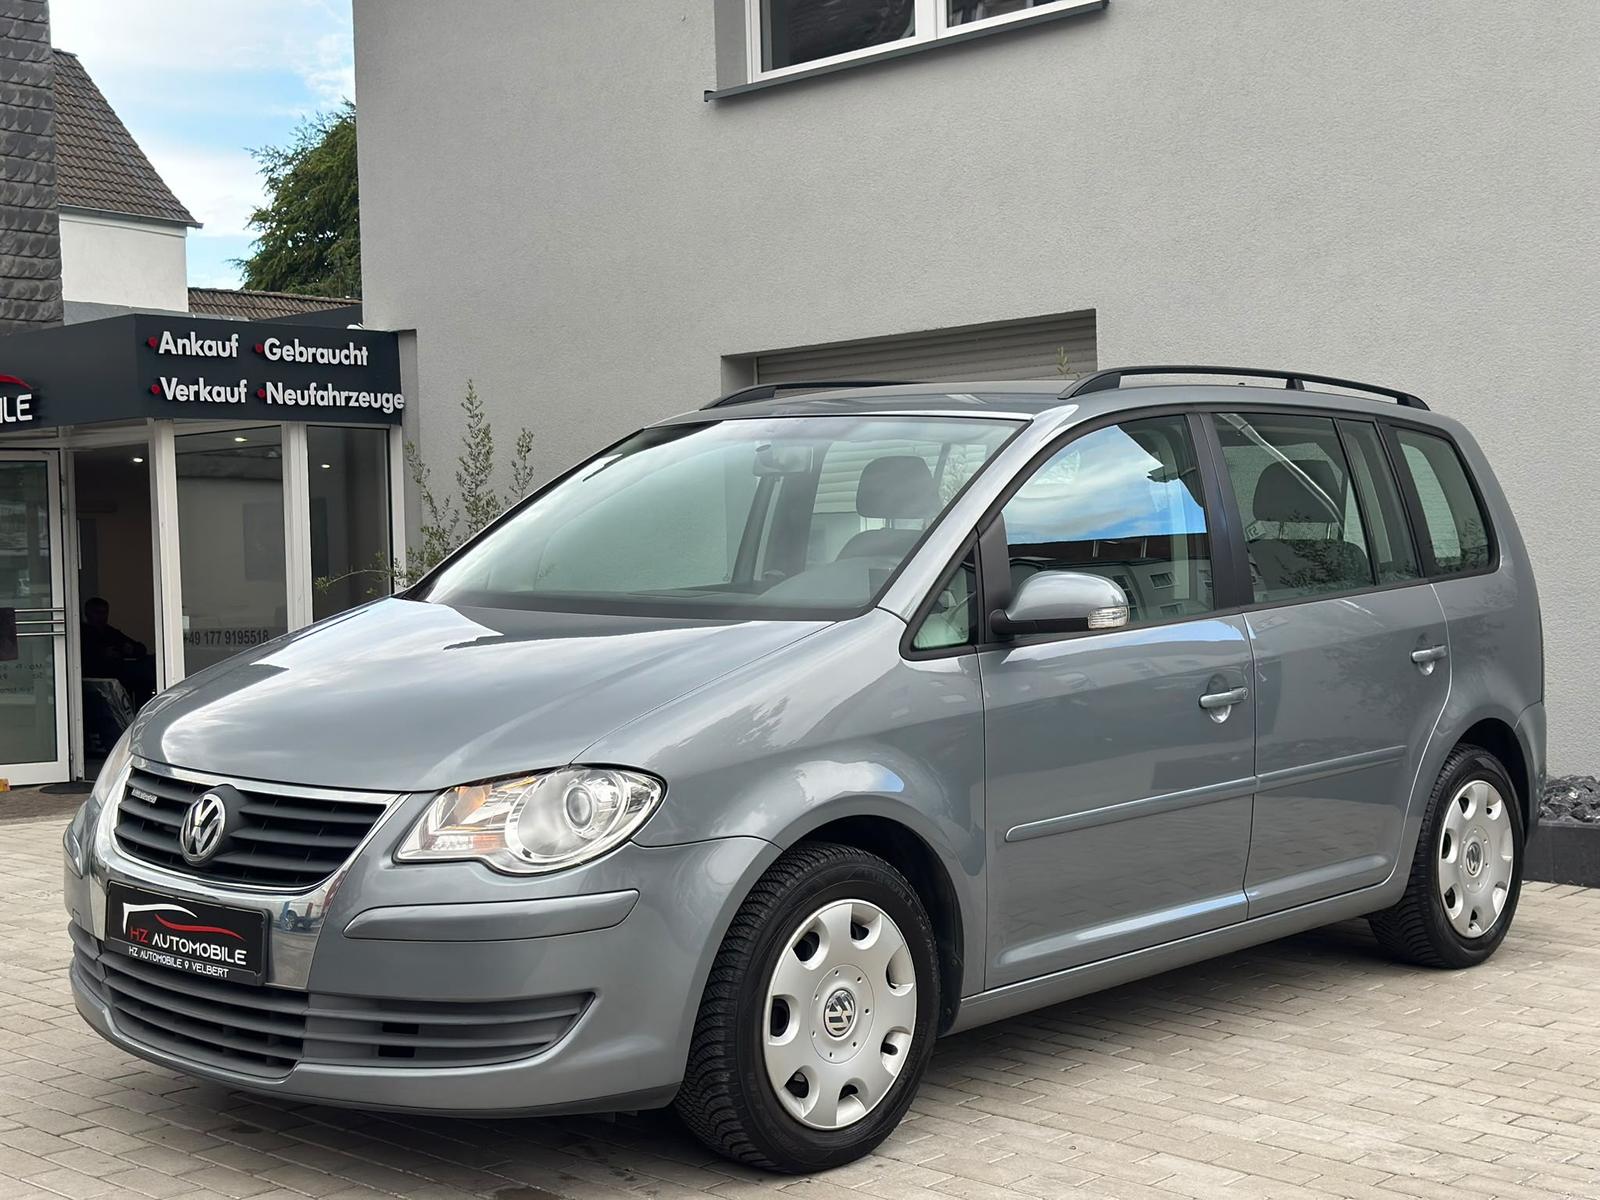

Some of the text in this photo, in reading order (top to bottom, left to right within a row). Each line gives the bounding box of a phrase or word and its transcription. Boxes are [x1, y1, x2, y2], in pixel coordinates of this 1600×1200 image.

[158, 330, 239, 358] Ankauf
[264, 337, 368, 366] Gebraucht
[160, 376, 247, 403] Verkauf
[265, 381, 405, 414] Neufahrzeuge
[204, 631, 221, 645] 177
[225, 630, 269, 645] 9195518
[181, 793, 226, 862] VW
[130, 927, 247, 965] HZ AUTOMOBILE
[128, 946, 229, 978] HZ AUTOMOBILE VELBERT
